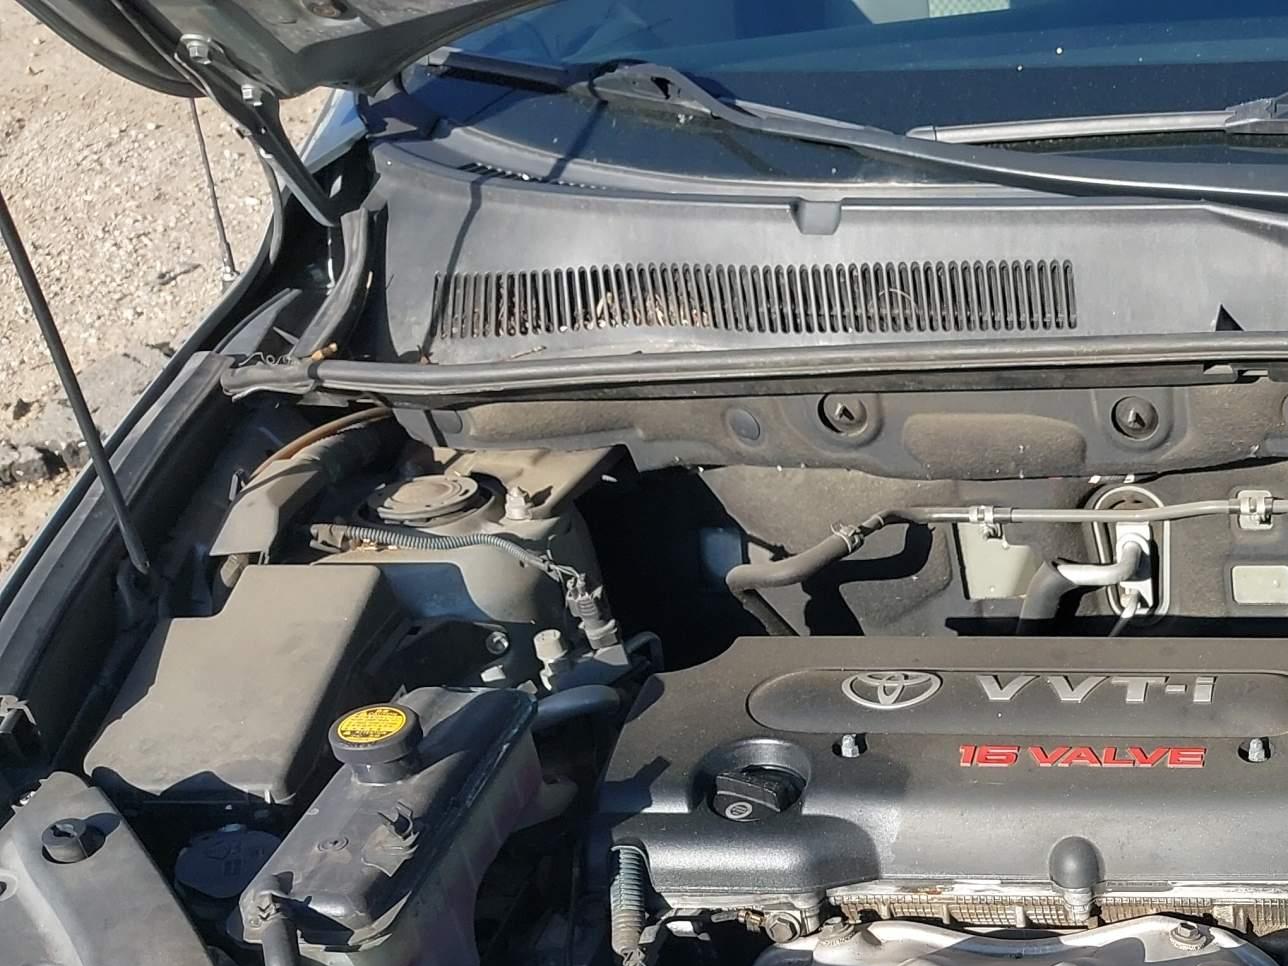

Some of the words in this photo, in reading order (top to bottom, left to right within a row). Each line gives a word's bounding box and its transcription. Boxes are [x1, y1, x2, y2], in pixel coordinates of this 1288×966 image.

[976, 675, 1217, 703] VVT-i
[959, 745, 1020, 767] 16
[1029, 745, 1207, 768] VALVE
